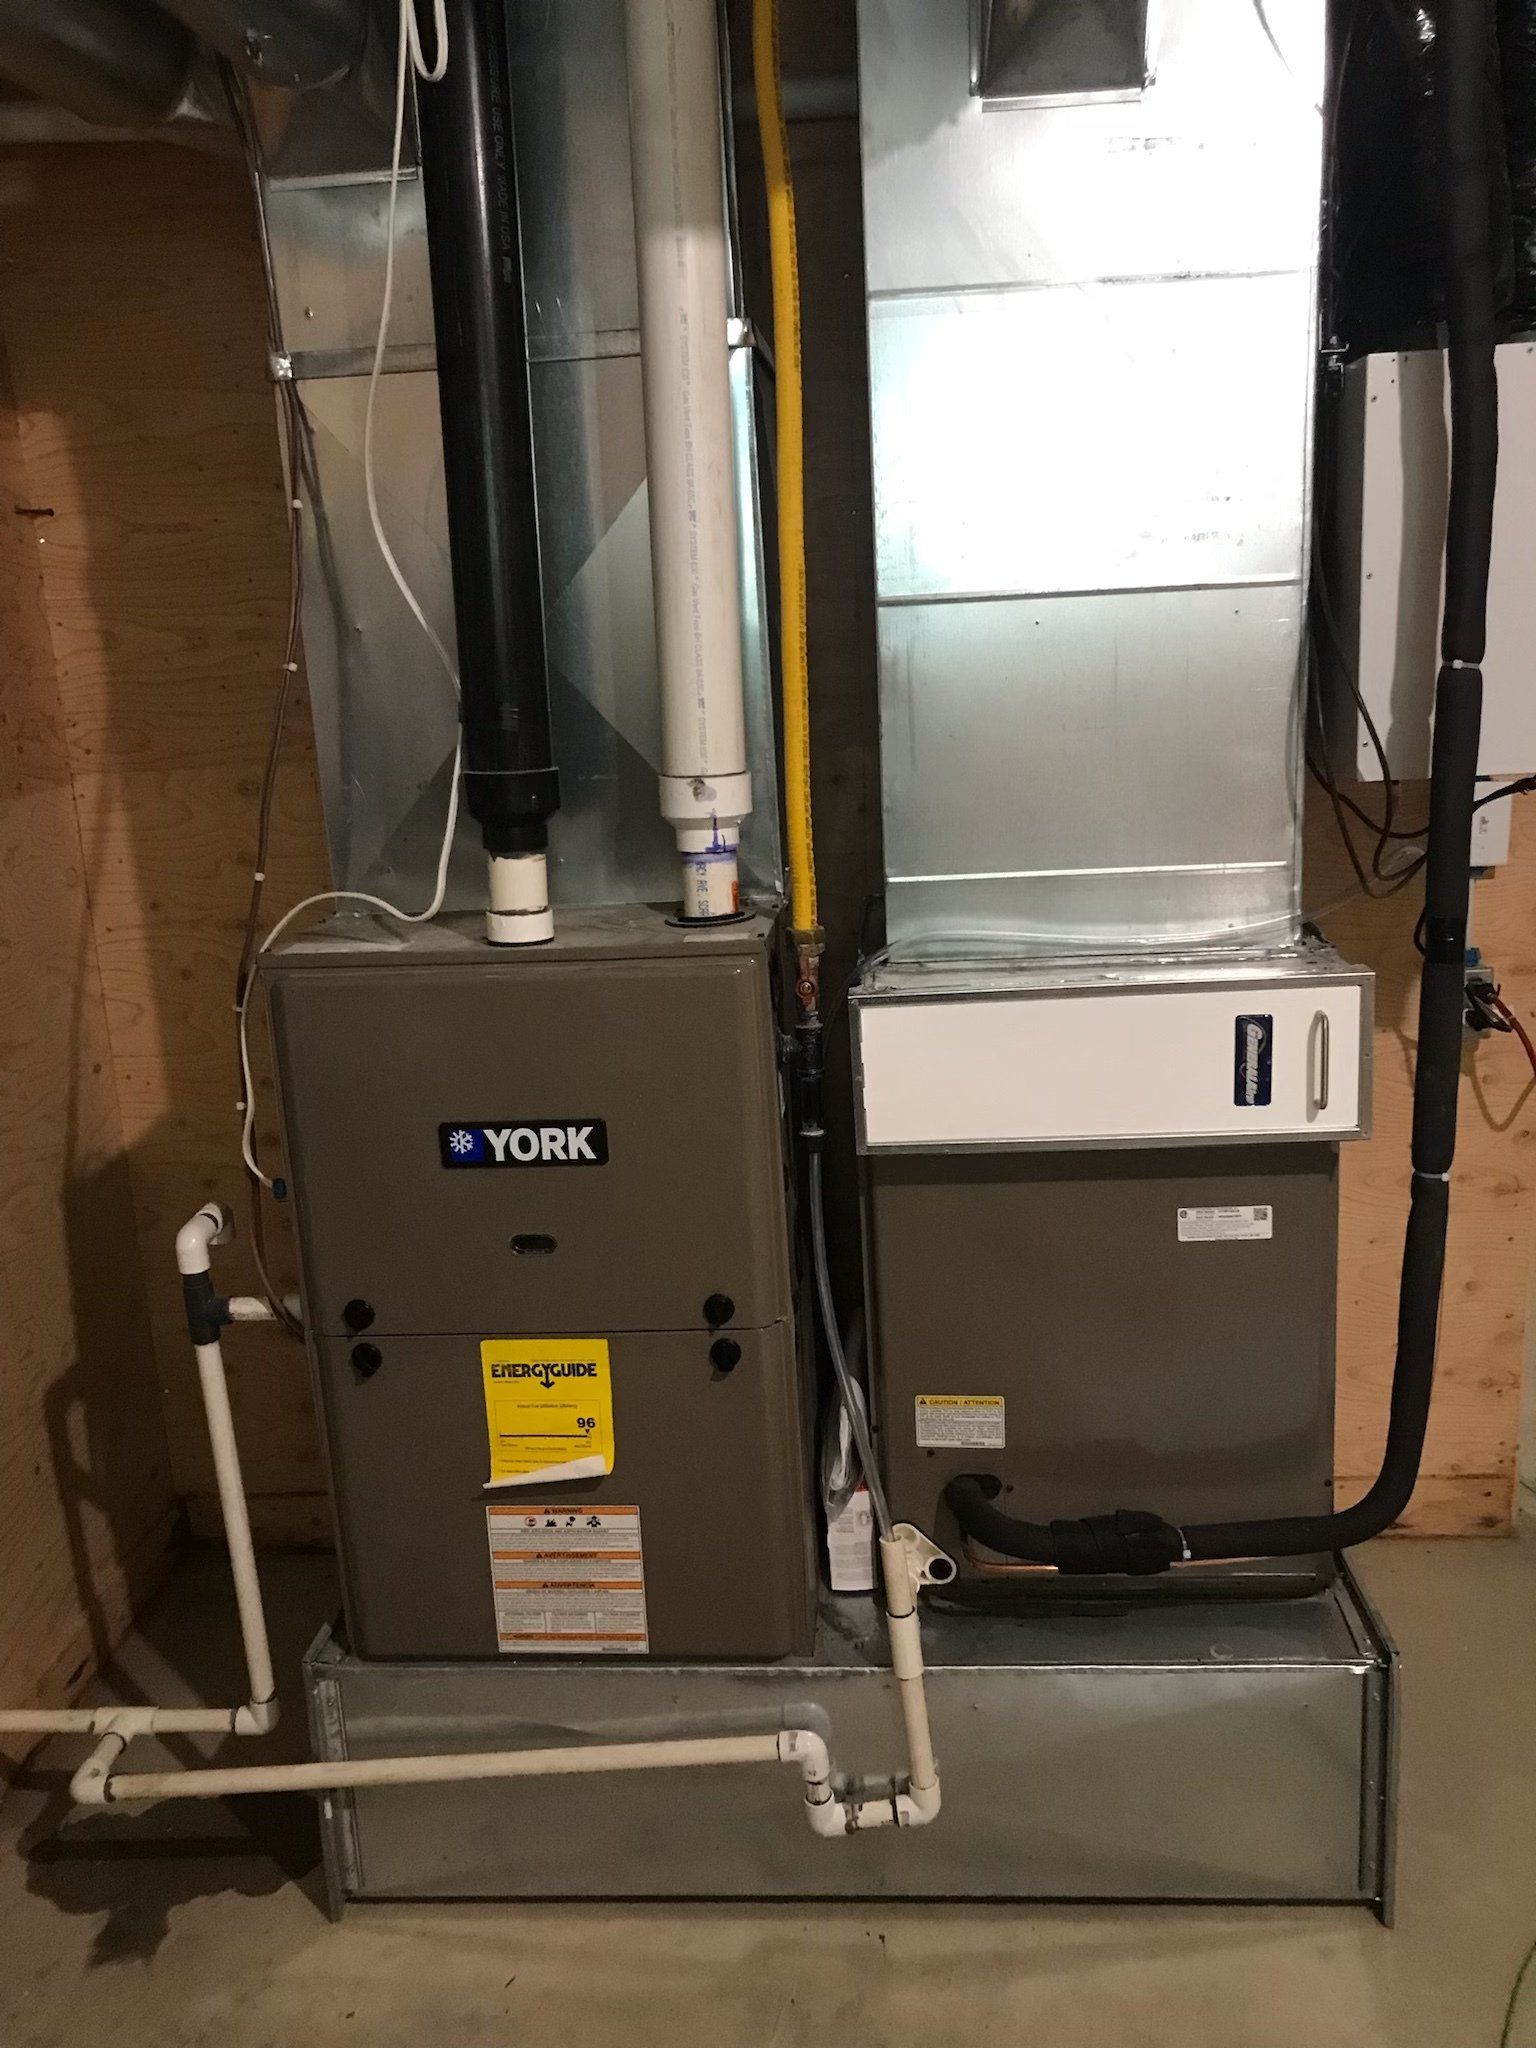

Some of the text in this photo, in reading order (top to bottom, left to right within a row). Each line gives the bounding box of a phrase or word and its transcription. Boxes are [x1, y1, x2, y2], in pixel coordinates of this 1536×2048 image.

[492, 106, 504, 132] USE
[494, 134, 508, 171] ONLY
[483, 1126, 597, 1162] YORK
[491, 1363, 598, 1381] ENERGYGUIDE
[576, 1417, 596, 1429] 96
